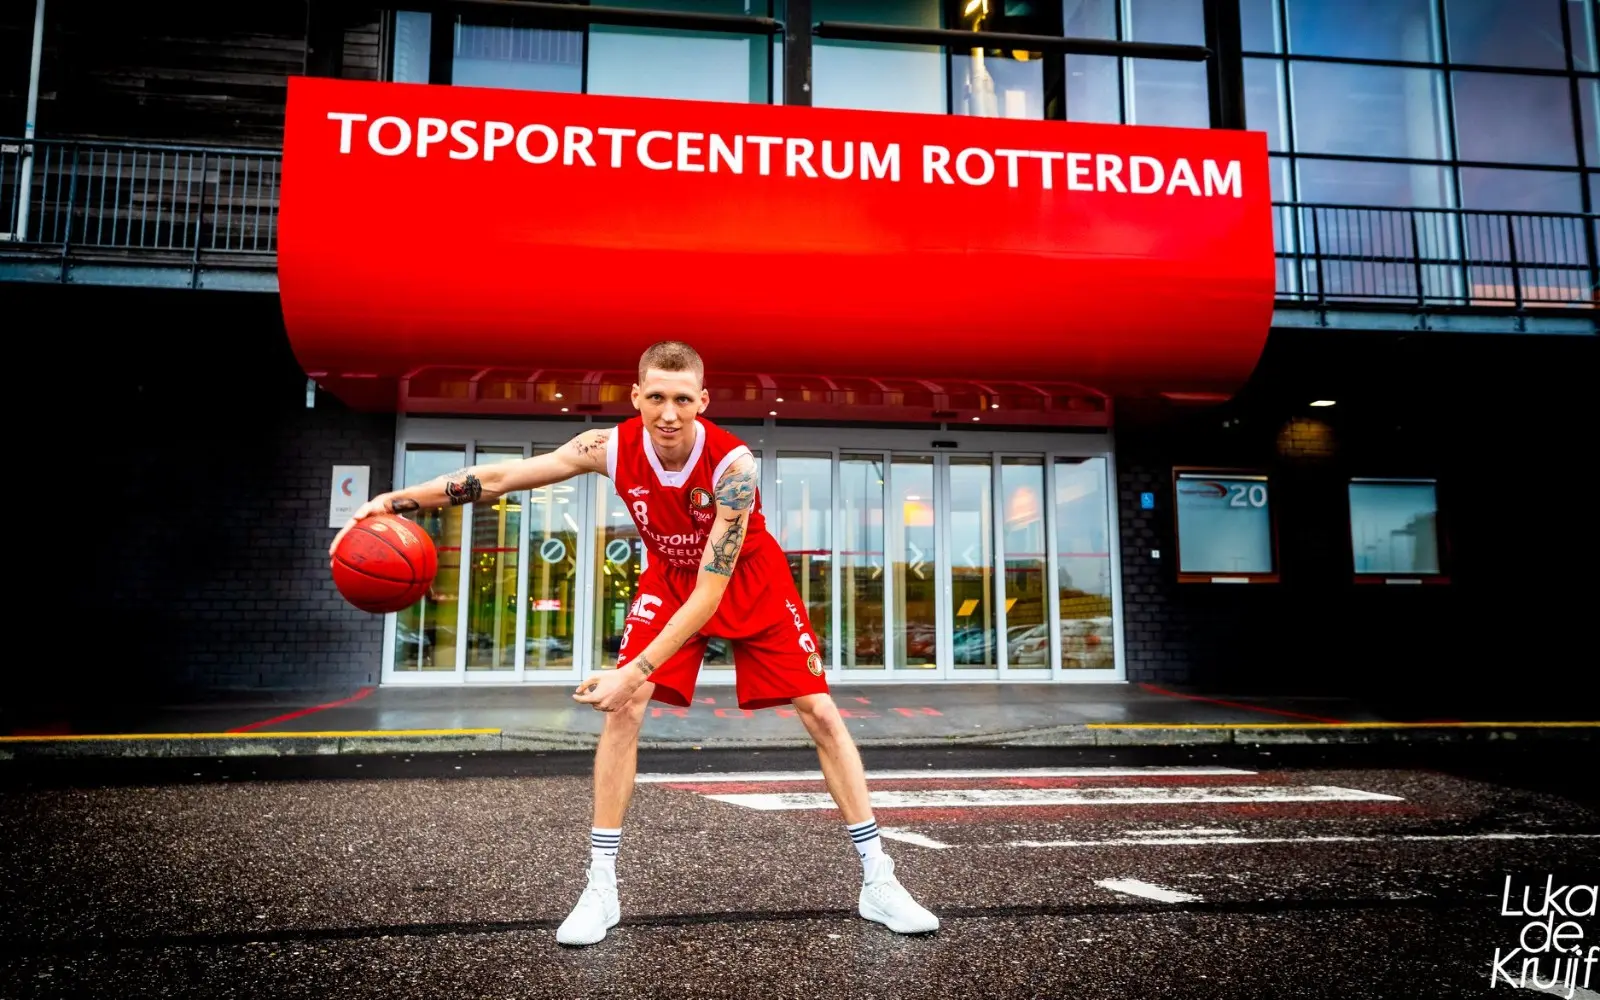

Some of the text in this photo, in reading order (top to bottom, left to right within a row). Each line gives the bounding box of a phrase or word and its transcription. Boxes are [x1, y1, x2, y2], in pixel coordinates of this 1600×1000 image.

[327, 111, 1243, 199] TOPSPORTCENTRUM ROTTERDAM
[1230, 483, 1267, 508] 20
[632, 500, 649, 526] 8
